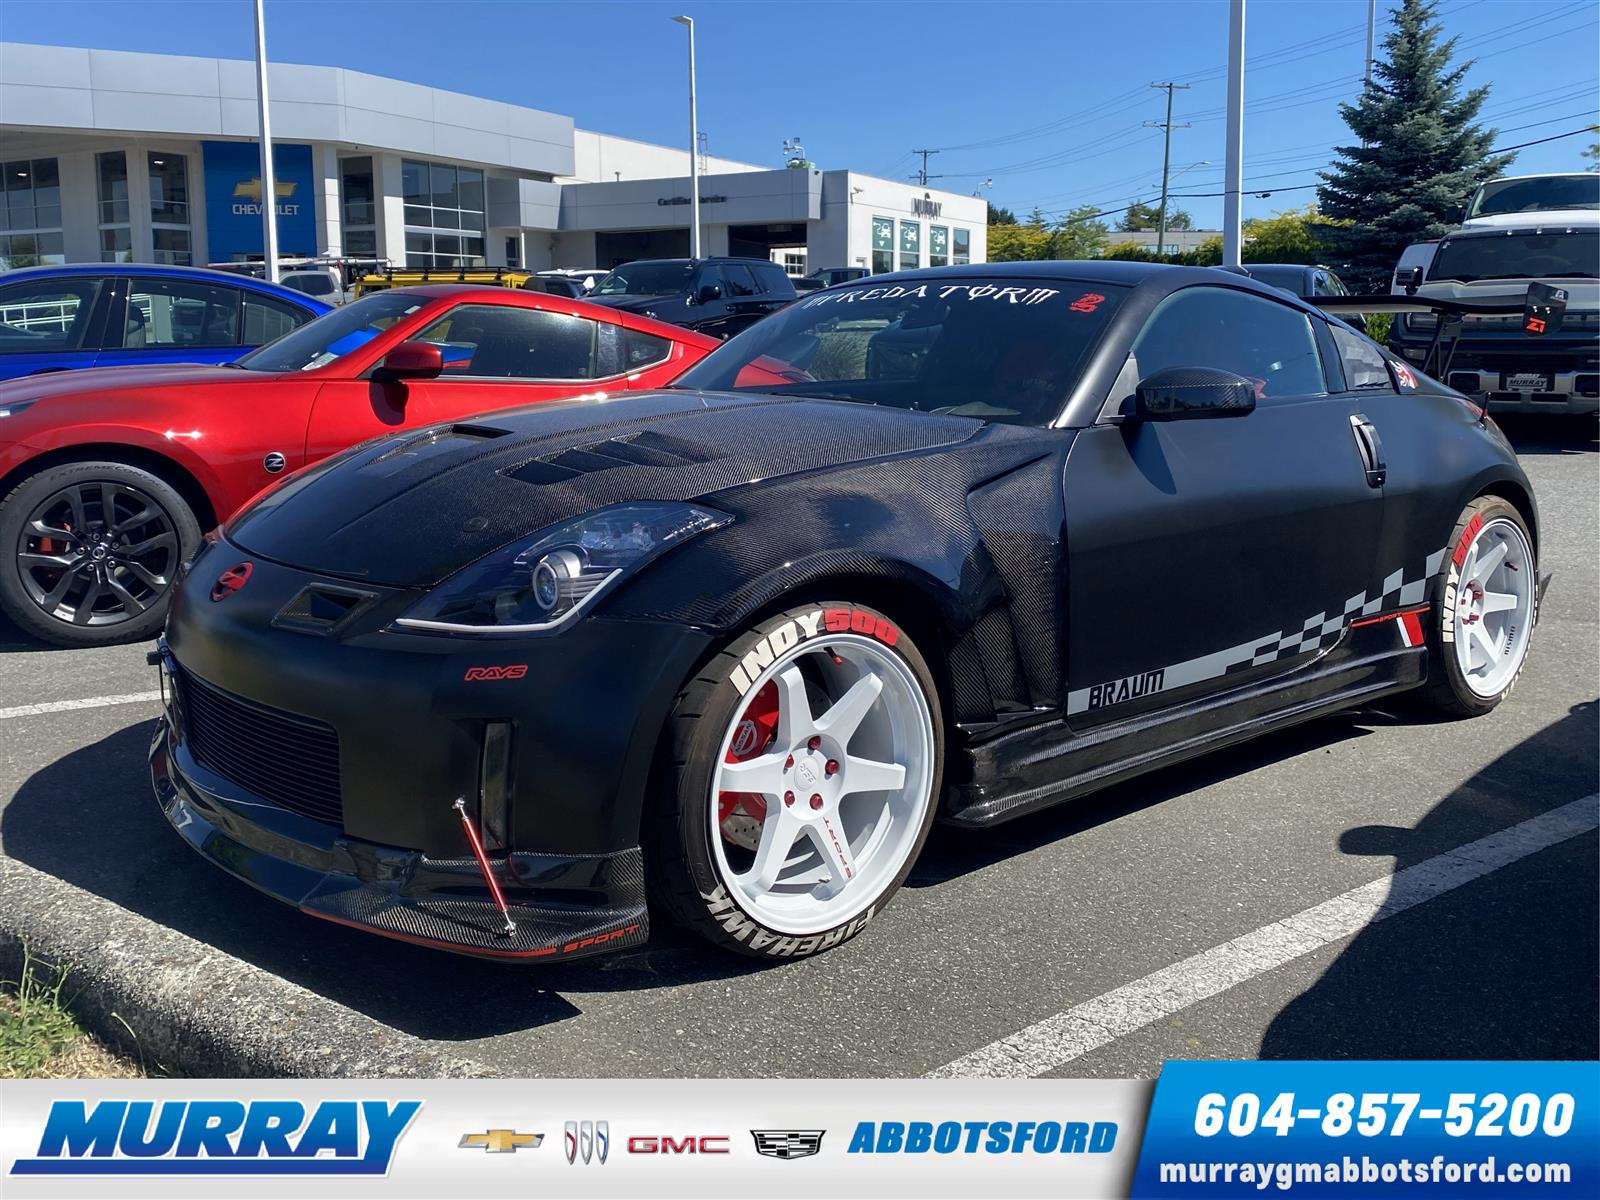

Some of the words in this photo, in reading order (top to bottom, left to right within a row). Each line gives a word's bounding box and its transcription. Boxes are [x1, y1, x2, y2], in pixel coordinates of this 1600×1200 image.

[232, 204, 300, 215] CHEVLET
[464, 665, 528, 681] RAYS
[1088, 668, 1165, 710] BRAUM
[700, 883, 876, 957] FIREHAWK
[563, 925, 640, 952] SPORT
